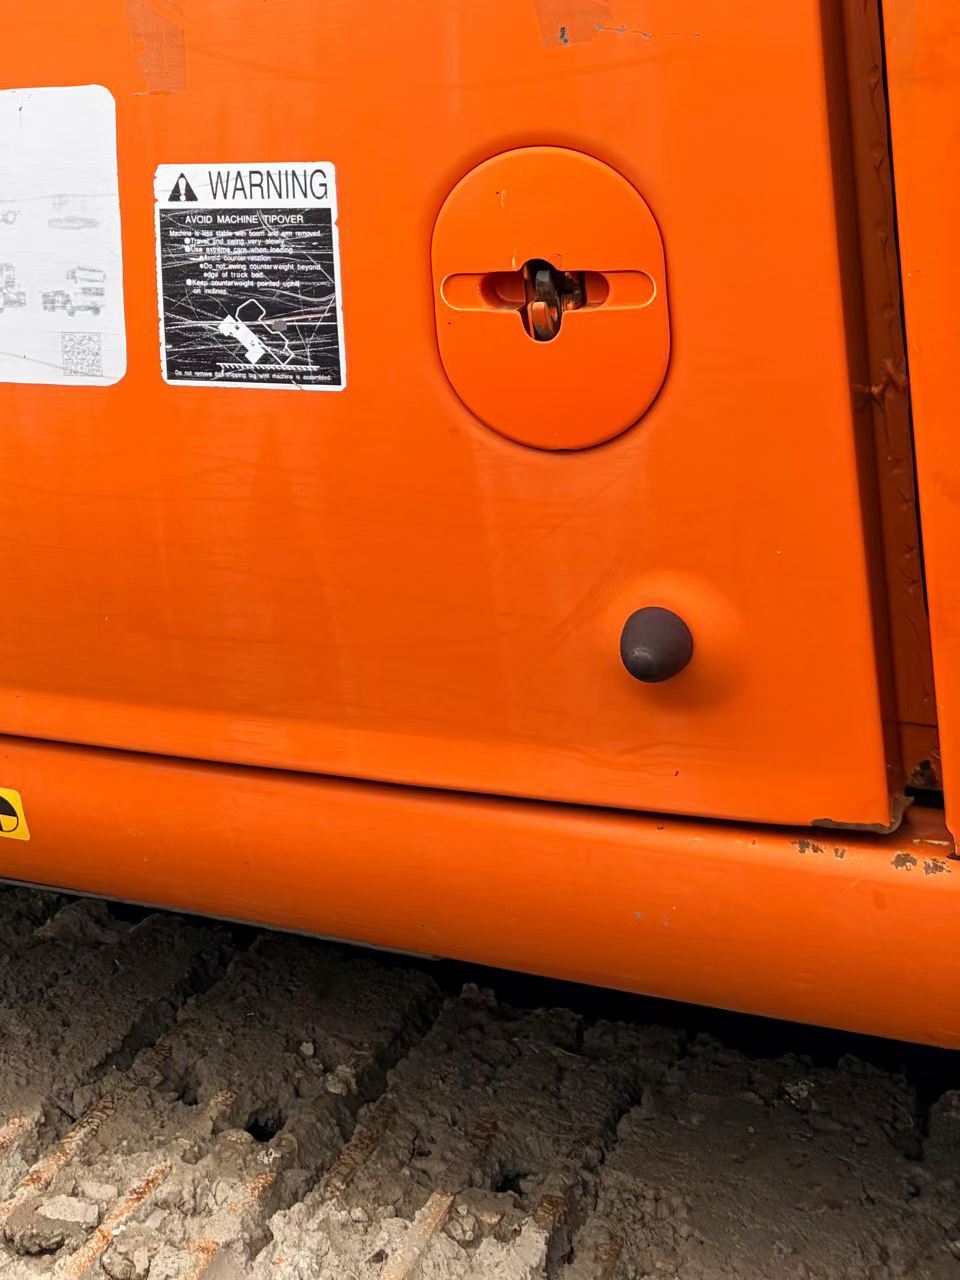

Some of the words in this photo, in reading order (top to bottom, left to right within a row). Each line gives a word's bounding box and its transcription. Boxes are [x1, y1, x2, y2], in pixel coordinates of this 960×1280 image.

[208, 169, 328, 200] WARNING
[185, 215, 213, 224] AVOID
[216, 214, 259, 224] MACHINE
[263, 214, 304, 224] TIPOVER
[169, 229, 192, 237] Machine
[226, 238, 244, 246] swing
[248, 238, 262, 246] very
[206, 246, 231, 254] extreme
[250, 246, 268, 254] when
[203, 254, 221, 262] Avoid
[204, 262, 213, 270] Do
[227, 263, 247, 271] swing
[249, 263, 294, 271] counterweight
[203, 271, 219, 279] edge
[192, 279, 209, 287] Keep
[211, 279, 254, 287] counterweight
[256, 280, 280, 288] pointed
[225, 371, 247, 380] shipping
[248, 372, 257, 380] tag
